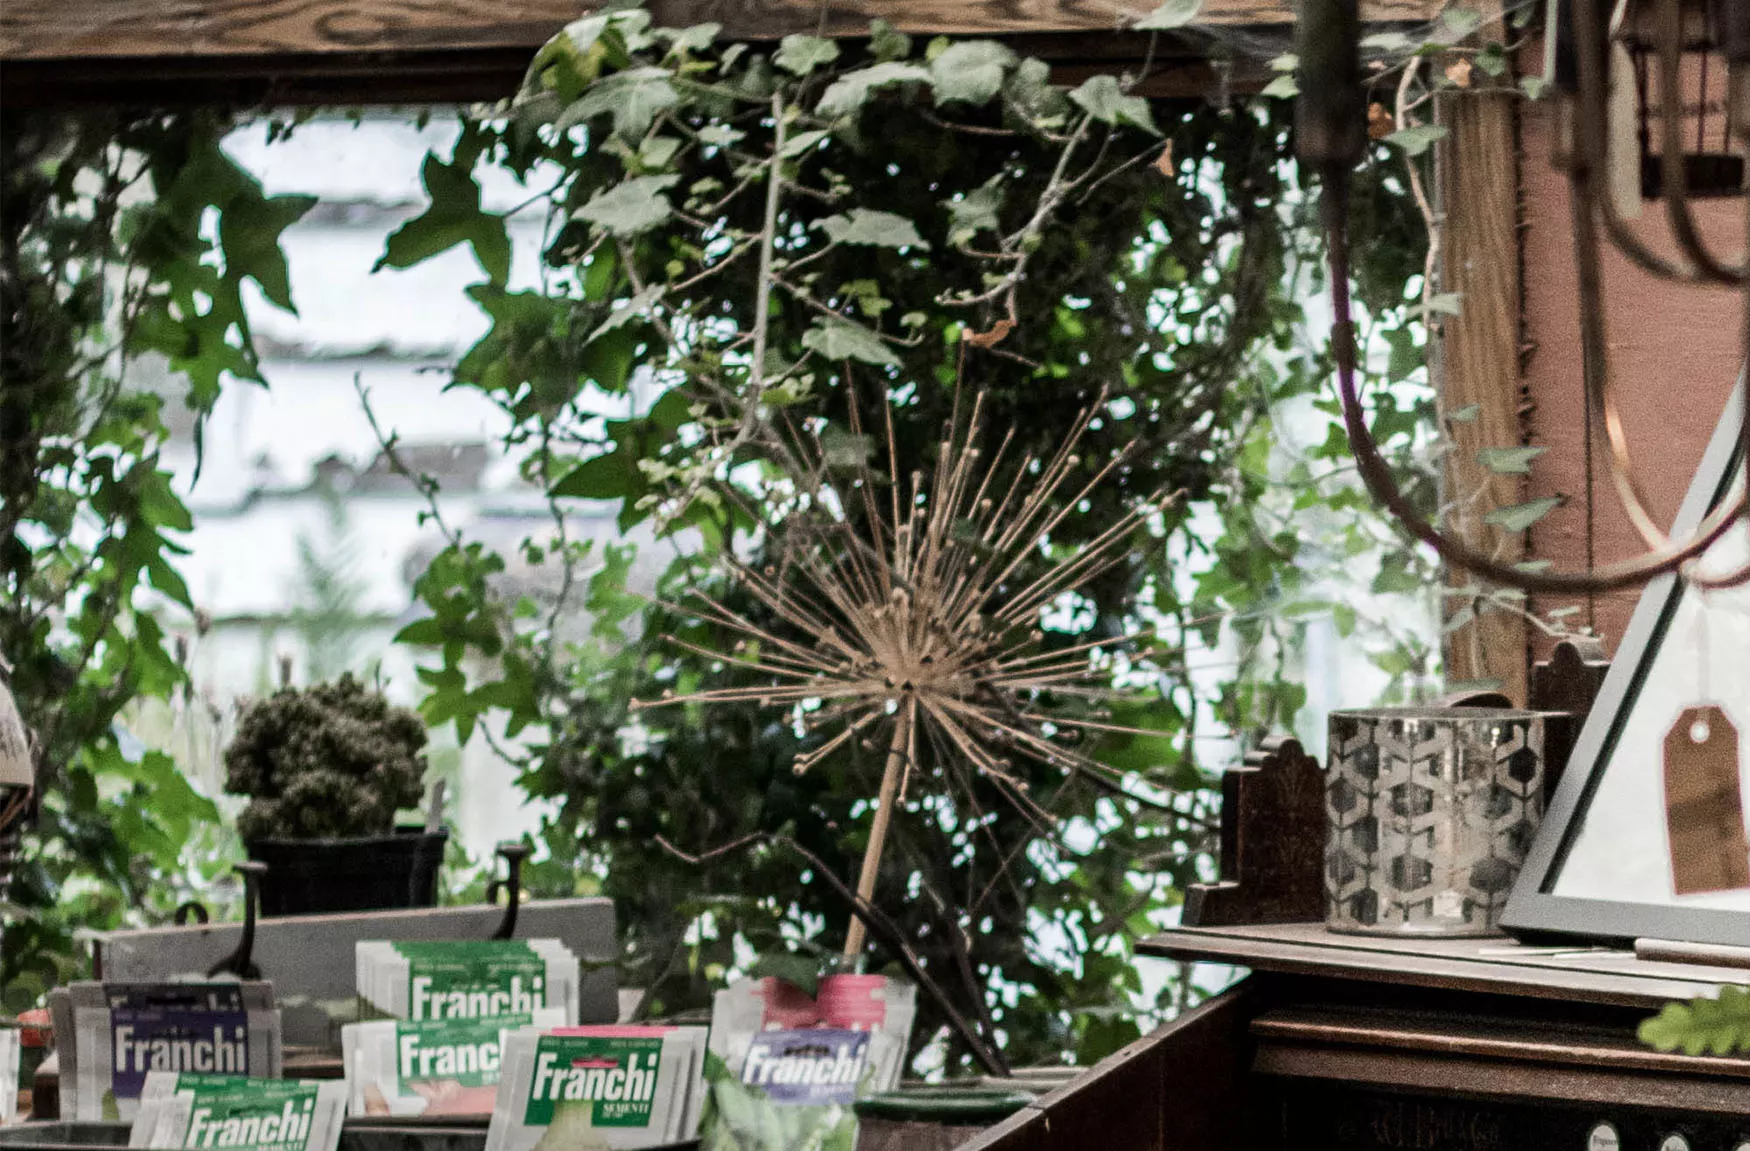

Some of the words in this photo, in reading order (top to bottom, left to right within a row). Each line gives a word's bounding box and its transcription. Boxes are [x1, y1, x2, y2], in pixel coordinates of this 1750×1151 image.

[412, 975, 543, 1021] Franchi
[115, 1024, 245, 1073] Franchi
[400, 1034, 500, 1078] Franc
[743, 1044, 866, 1085] Franchi
[532, 1052, 658, 1101] Franchi
[184, 1098, 314, 1151] Franchi
